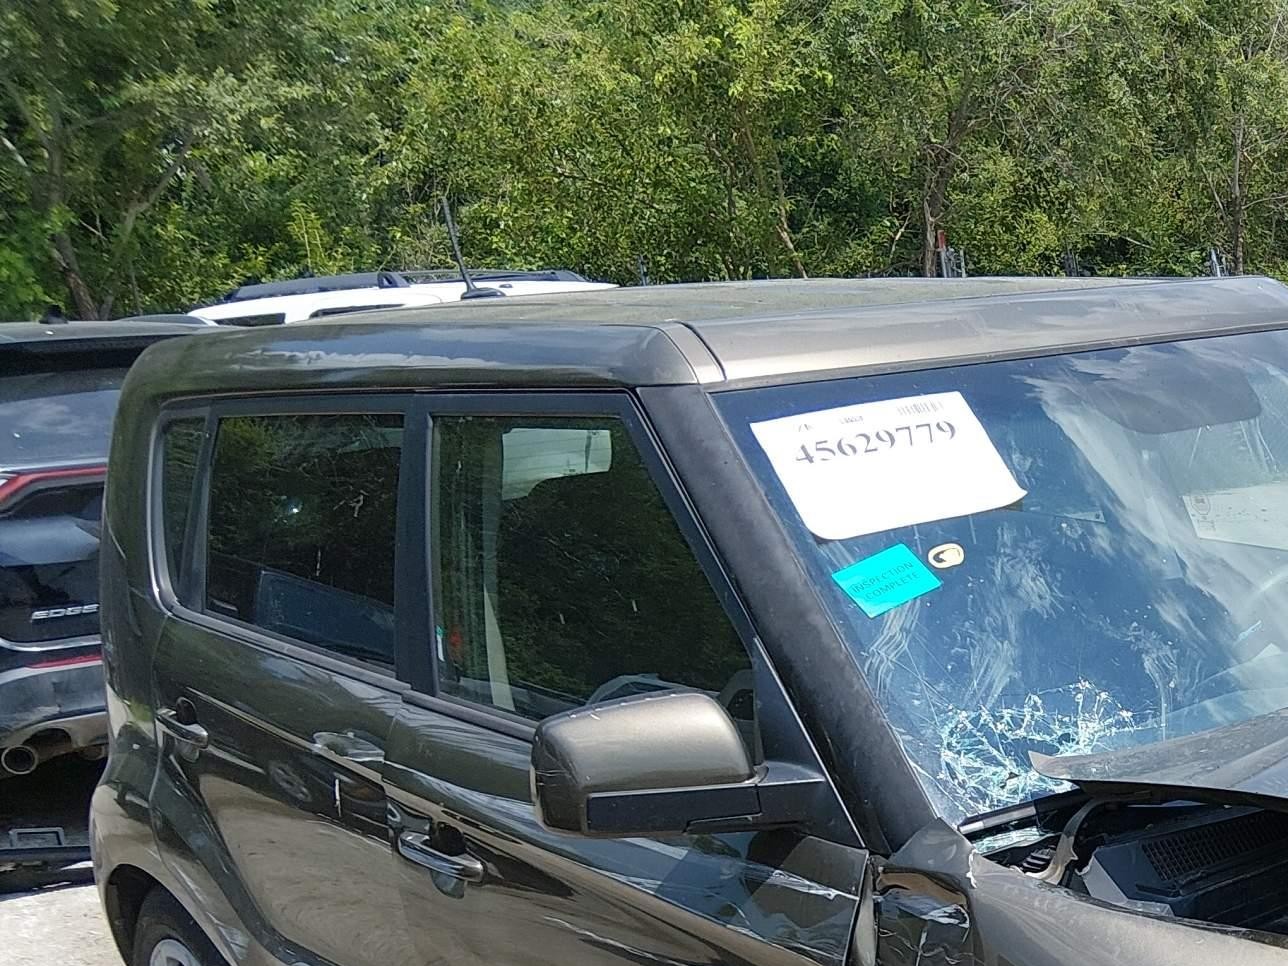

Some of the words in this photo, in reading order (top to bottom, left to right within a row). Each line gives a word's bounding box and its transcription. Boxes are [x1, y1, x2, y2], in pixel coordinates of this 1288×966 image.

[796, 420, 956, 464] 45629779
[851, 561, 913, 593] INSPECTION
[865, 572, 920, 601] COMPLETE
[31, 604, 99, 620] EDGE
